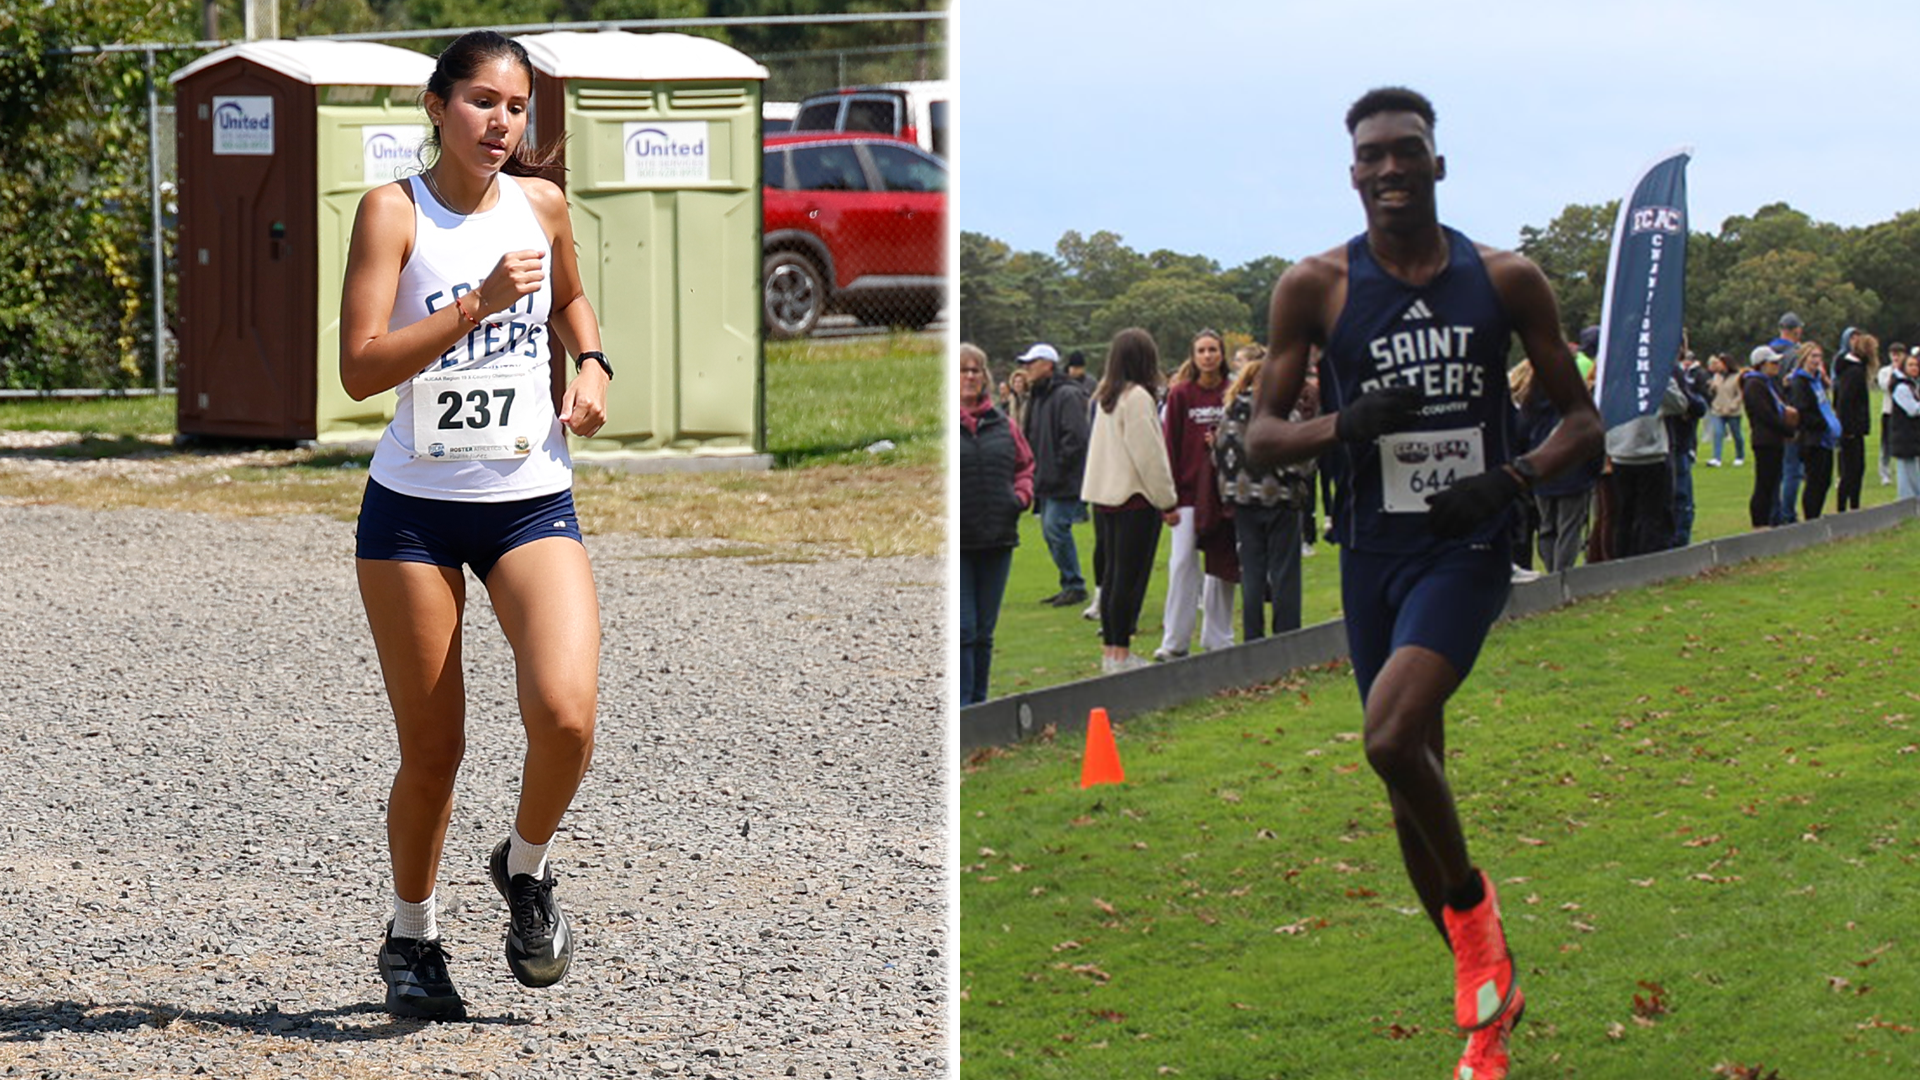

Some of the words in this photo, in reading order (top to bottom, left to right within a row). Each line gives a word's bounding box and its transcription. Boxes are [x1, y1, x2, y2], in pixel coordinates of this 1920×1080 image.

[220, 111, 270, 130] United
[636, 138, 704, 157] United
[419, 321, 542, 374] ETER'S
[1369, 326, 1474, 371] SAINT
[437, 387, 516, 430] 237
[1409, 467, 1456, 493] 644
